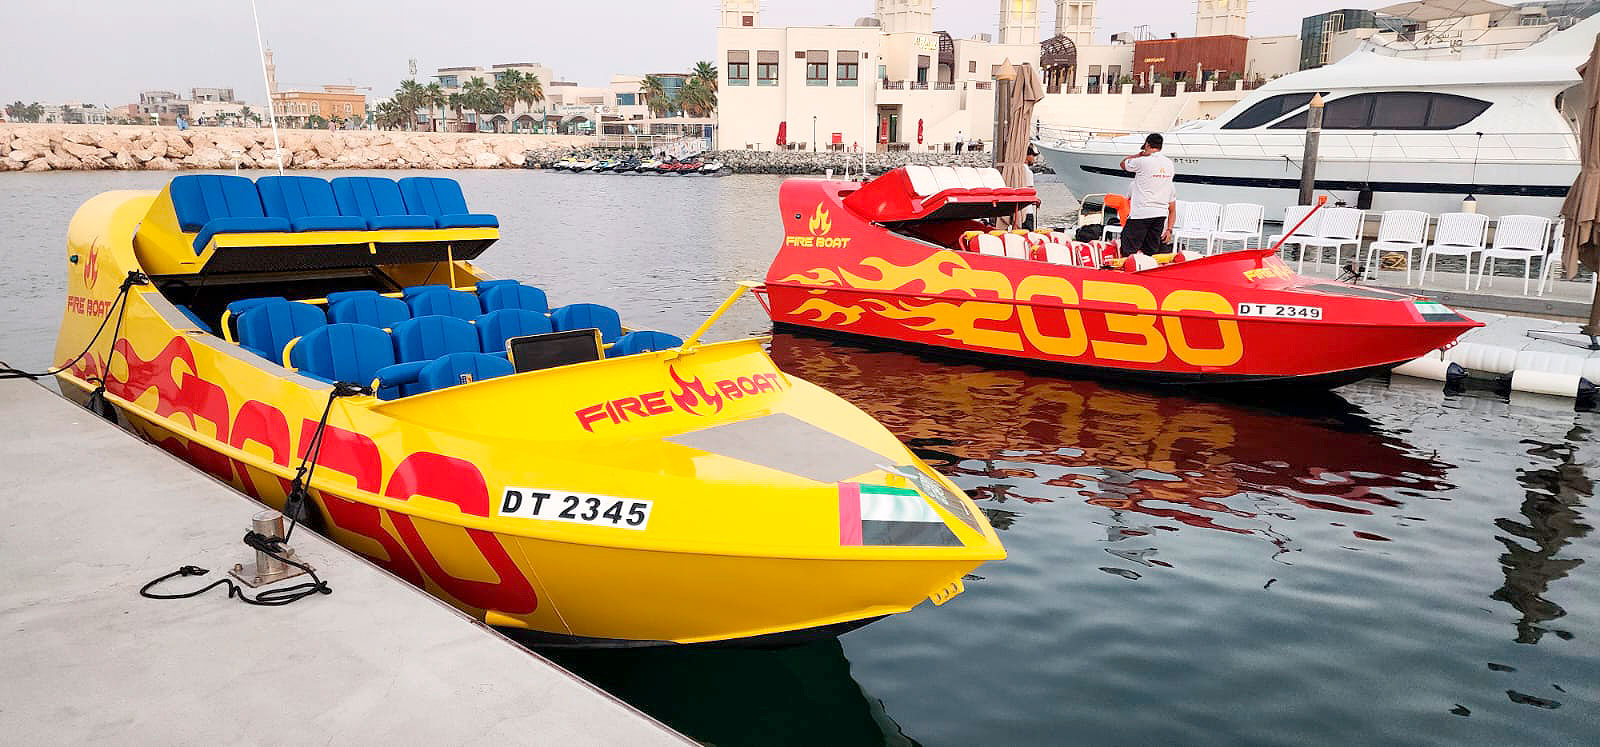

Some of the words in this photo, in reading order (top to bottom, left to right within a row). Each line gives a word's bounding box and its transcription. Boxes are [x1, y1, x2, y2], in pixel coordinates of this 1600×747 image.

[786, 236, 814, 247] FIRE
[815, 237, 851, 248] BOAT
[67, 295, 85, 314] FIRE
[86, 298, 112, 318] BOAT
[952, 268, 1243, 367] 2030
[1275, 305, 1321, 319] 2349
[575, 390, 674, 433] FIRE
[714, 373, 783, 401] BOAT
[558, 495, 648, 527] 2345
